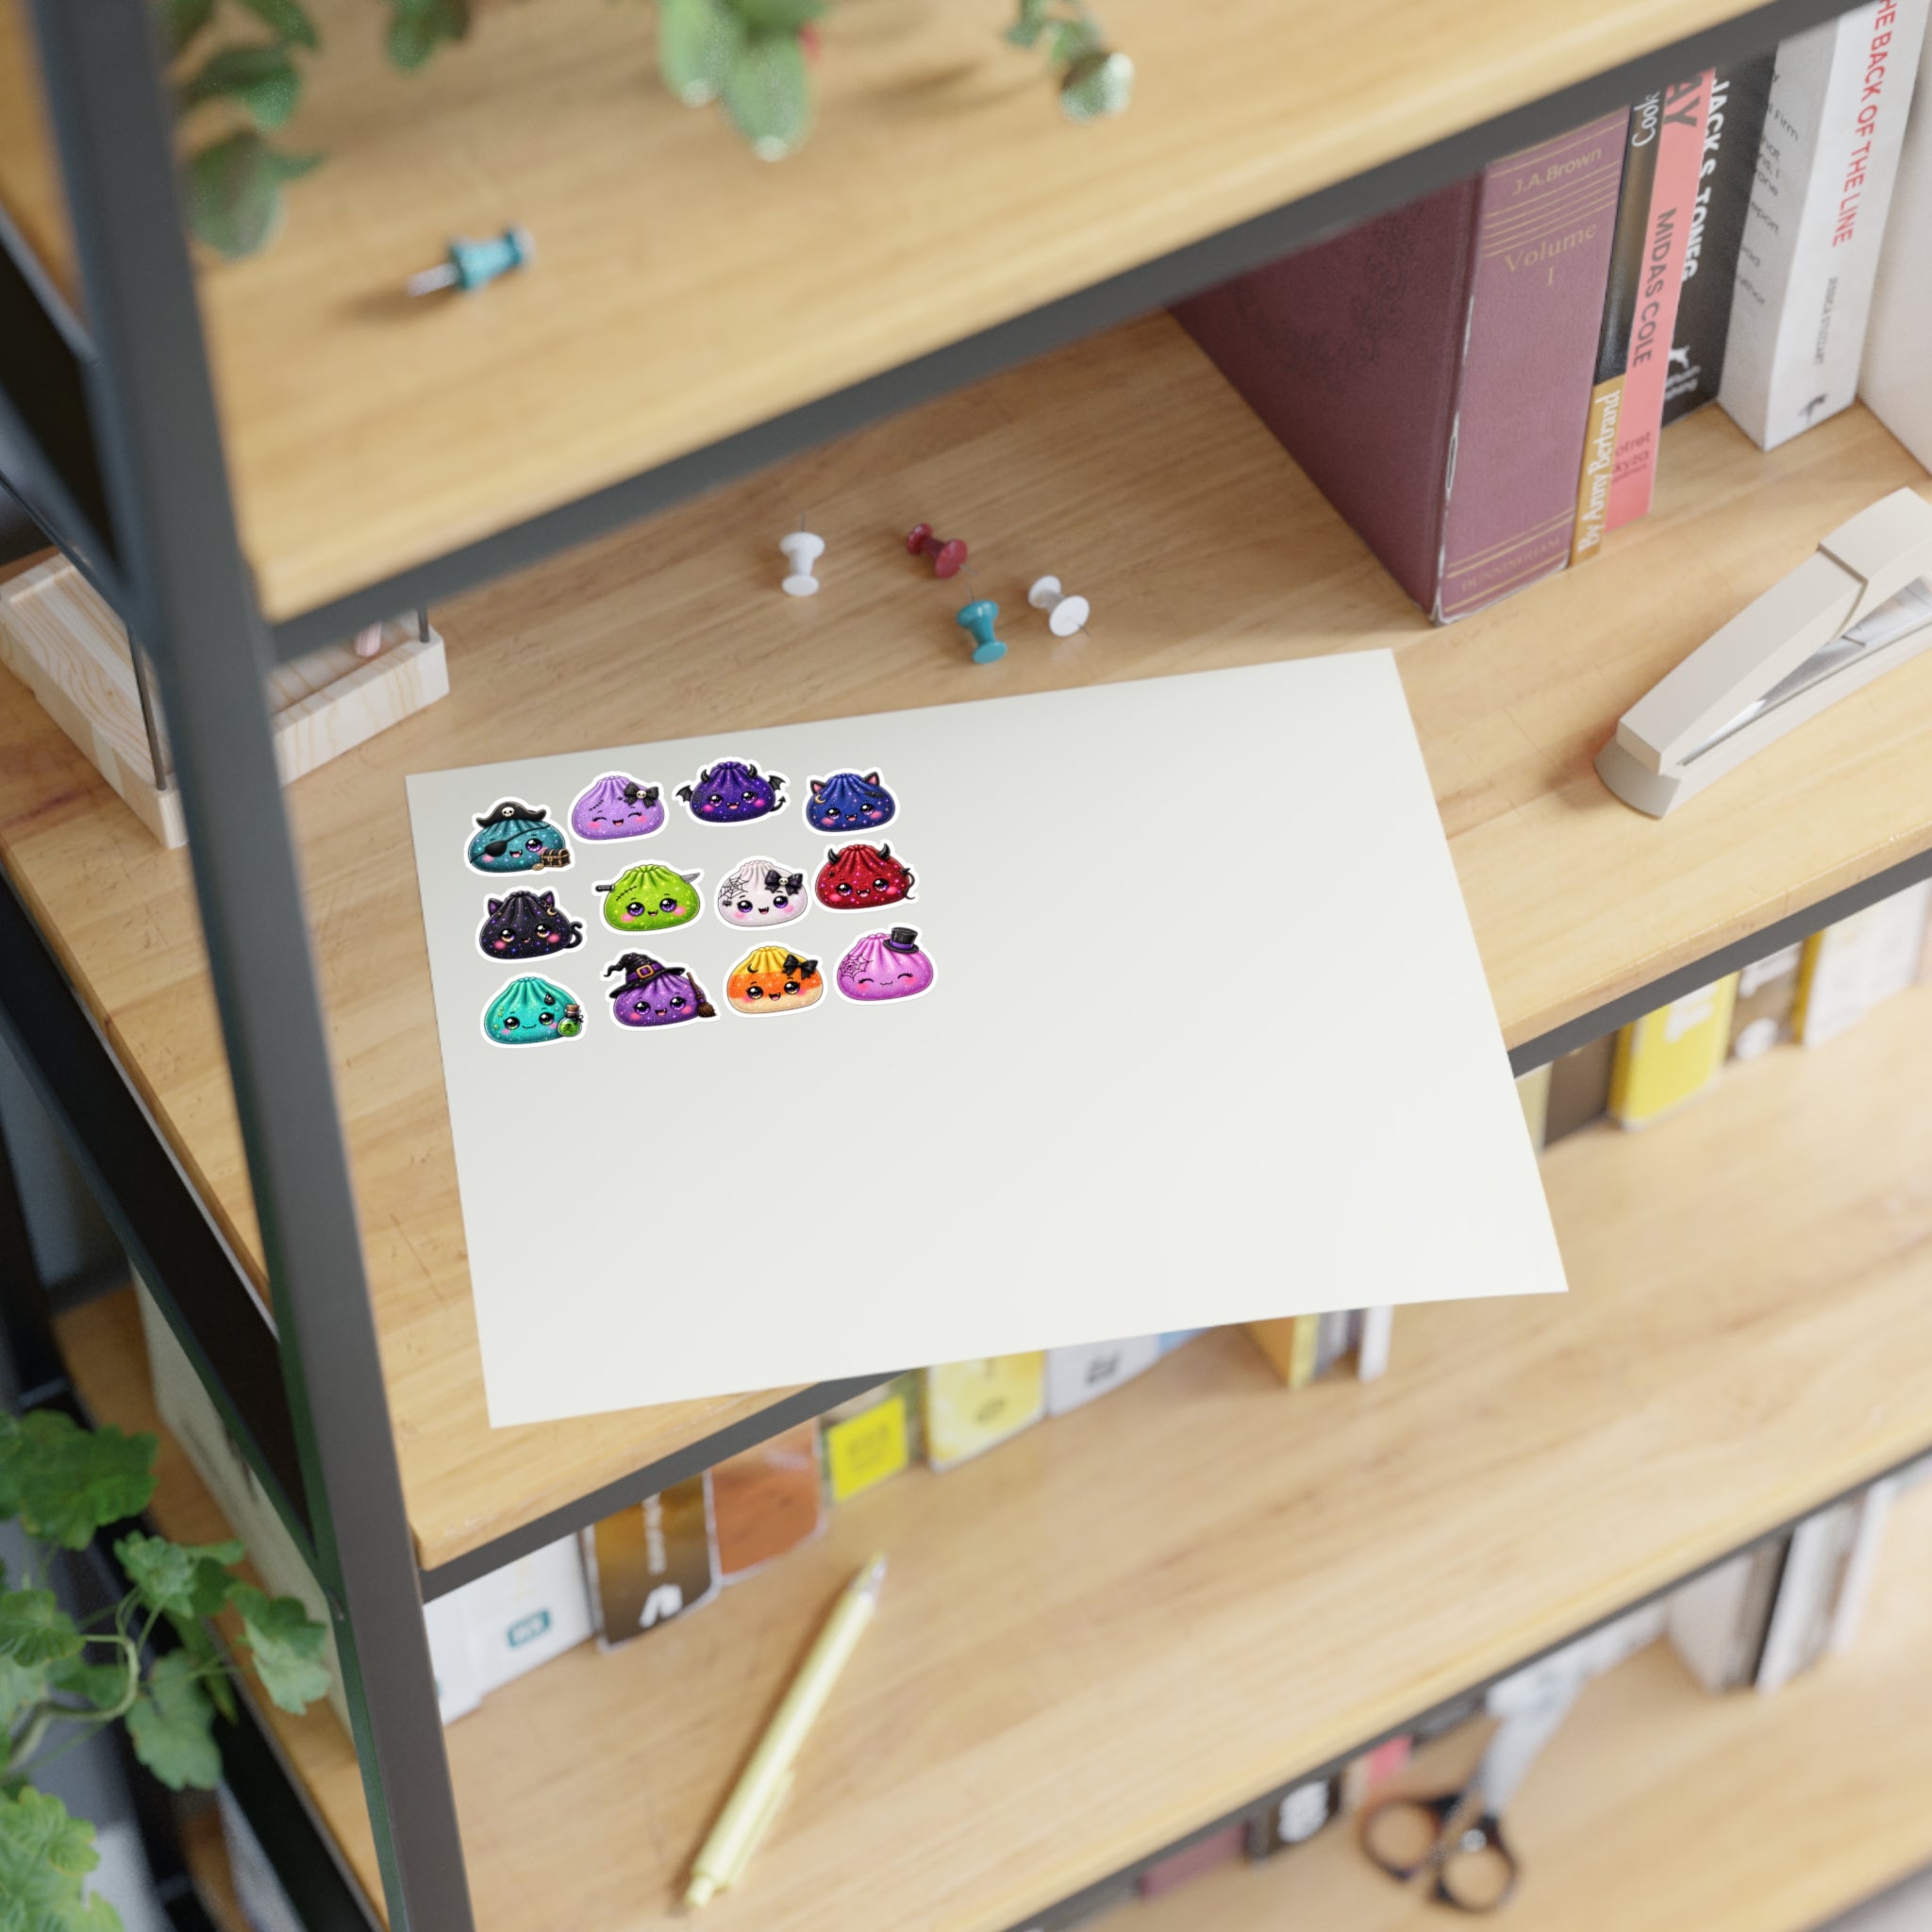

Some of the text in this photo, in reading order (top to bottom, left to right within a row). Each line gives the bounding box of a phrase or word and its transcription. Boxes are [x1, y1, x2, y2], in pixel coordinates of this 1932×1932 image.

[1704, 78, 1730, 152] JACK
[1832, 0, 1897, 247] HE BACK OF THE LINE
[1505, 224, 1597, 272] Volume
[1632, 208, 1676, 367] MIDAS COLE
[1588, 390, 1621, 475] Bertrand
[1577, 524, 1605, 553] By
